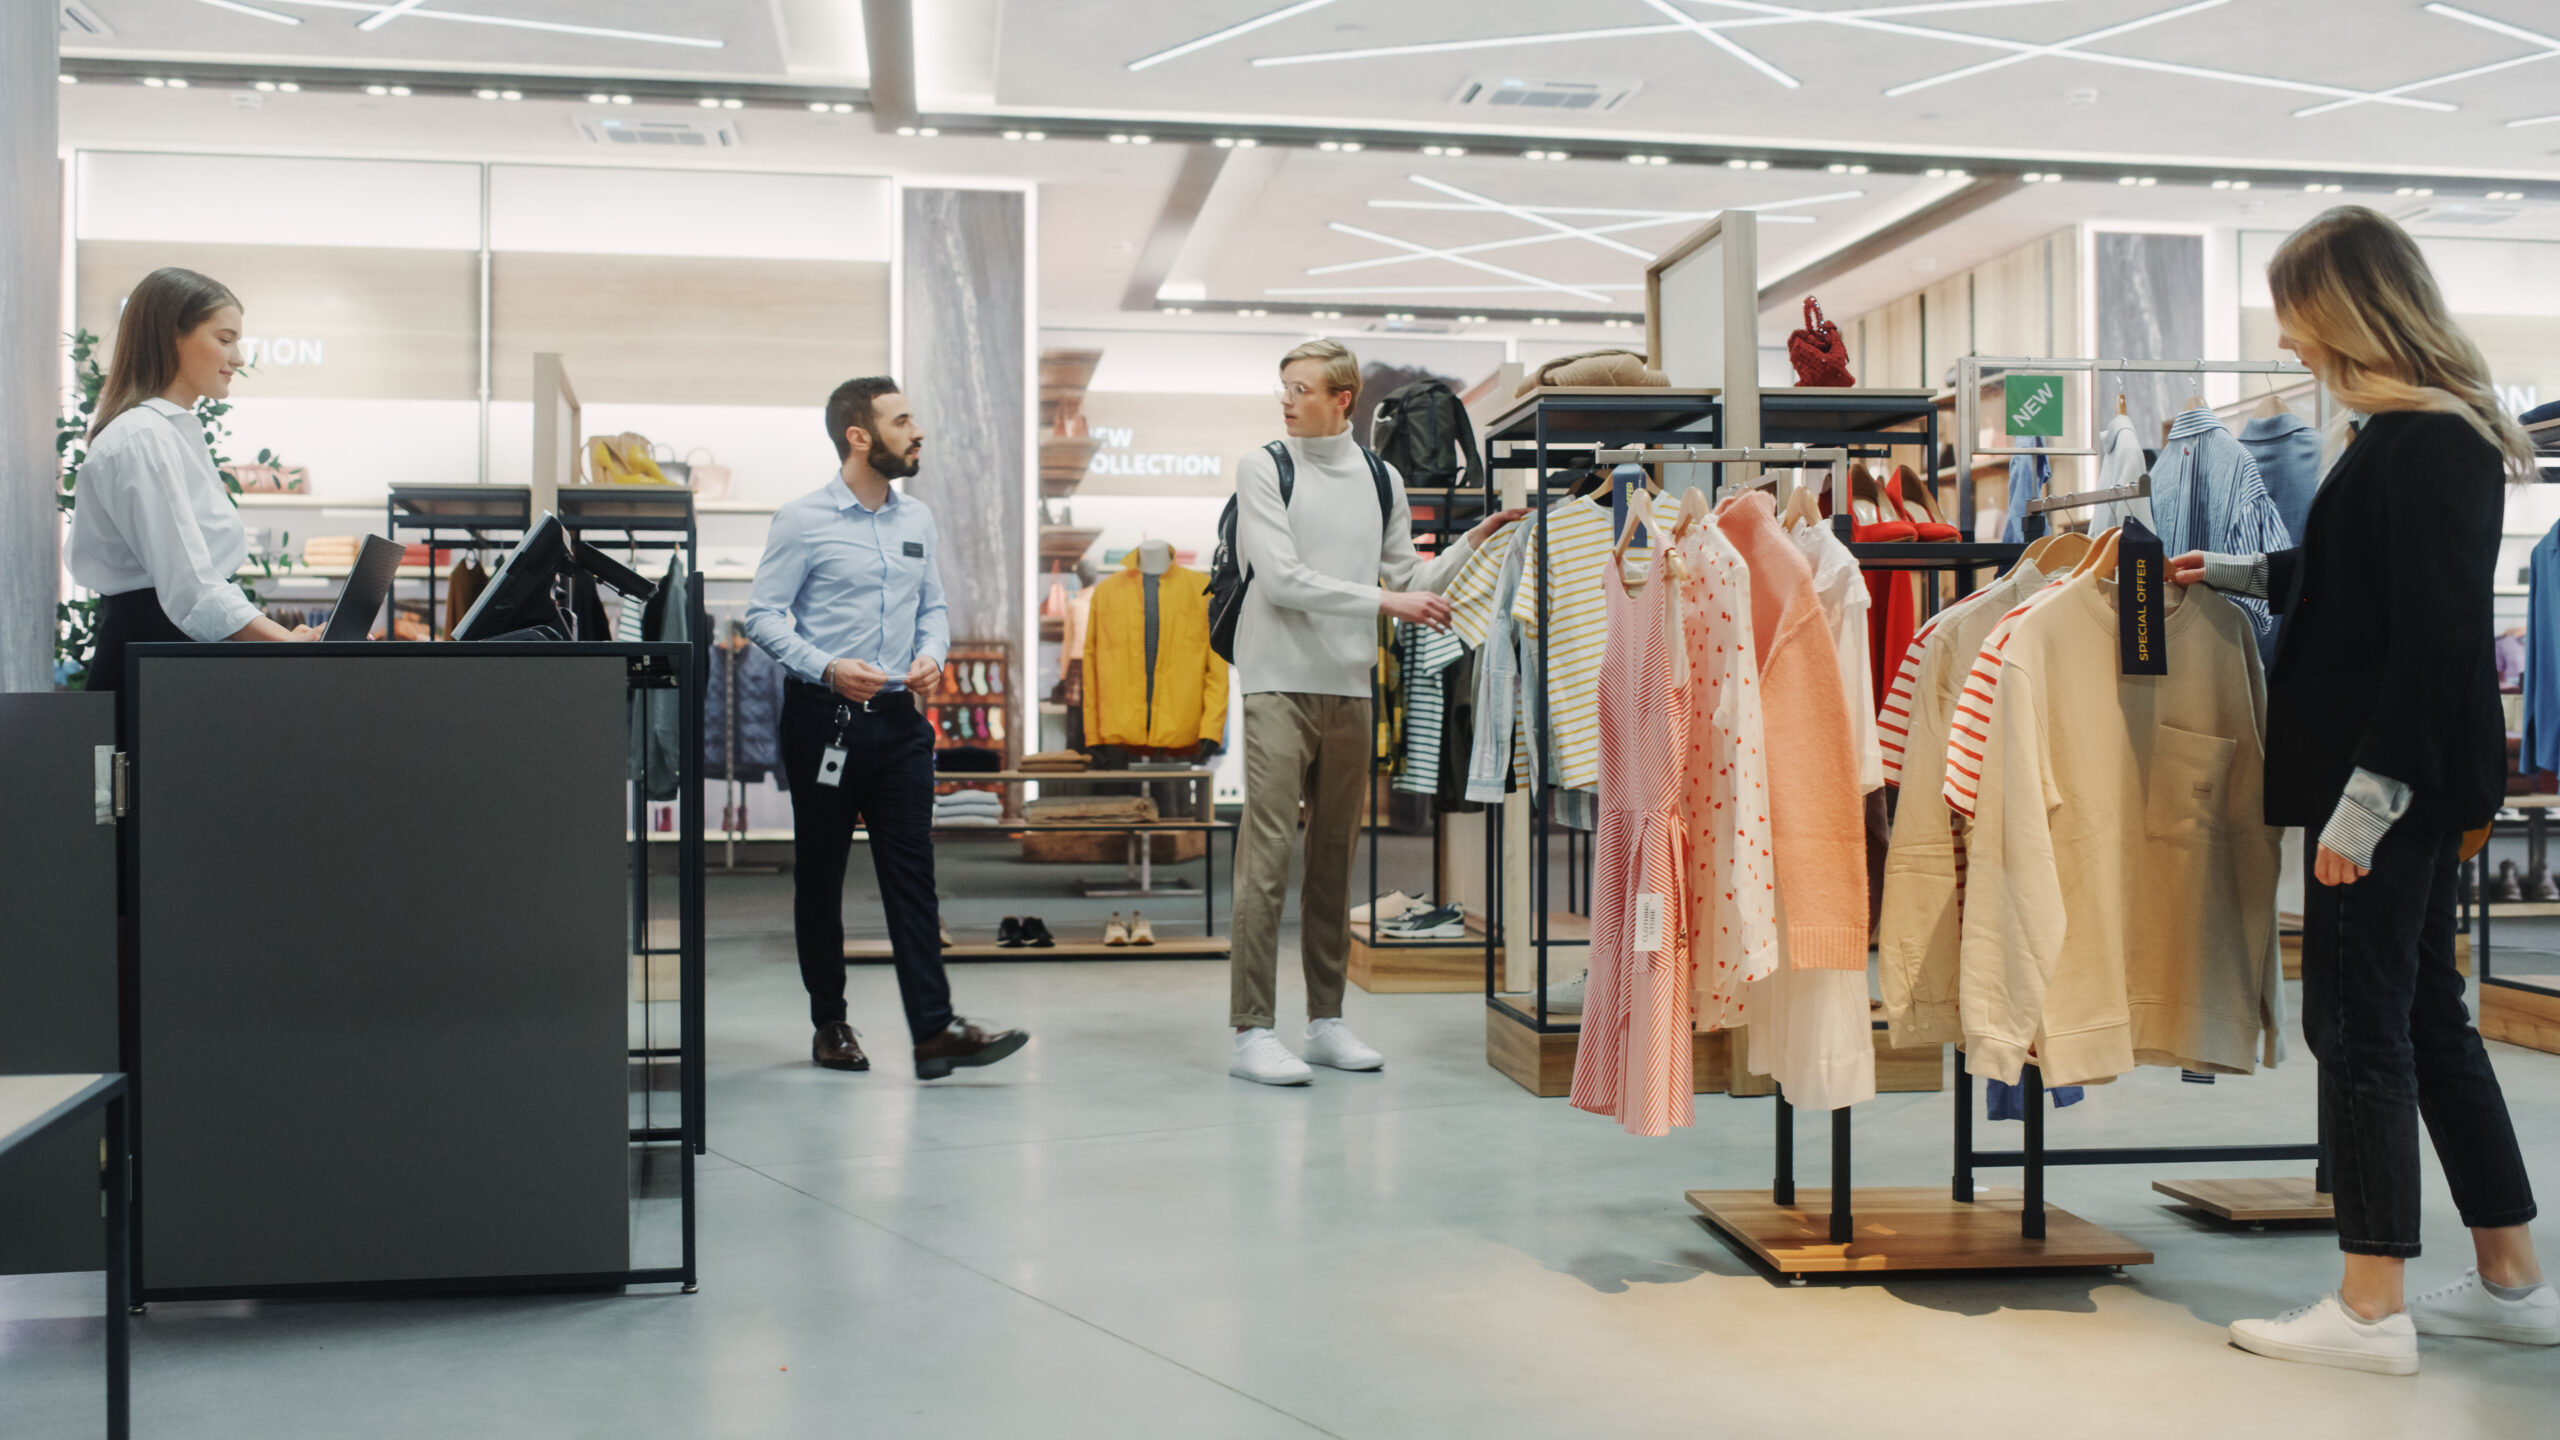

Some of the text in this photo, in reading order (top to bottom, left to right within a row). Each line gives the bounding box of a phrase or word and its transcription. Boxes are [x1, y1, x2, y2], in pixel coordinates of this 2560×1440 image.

[2012, 382, 2053, 427] NEW
[1088, 427, 1134, 448] EW
[1089, 452, 1222, 476] OLLECTION
[2136, 558, 2149, 662] SPECIAL OFFER
